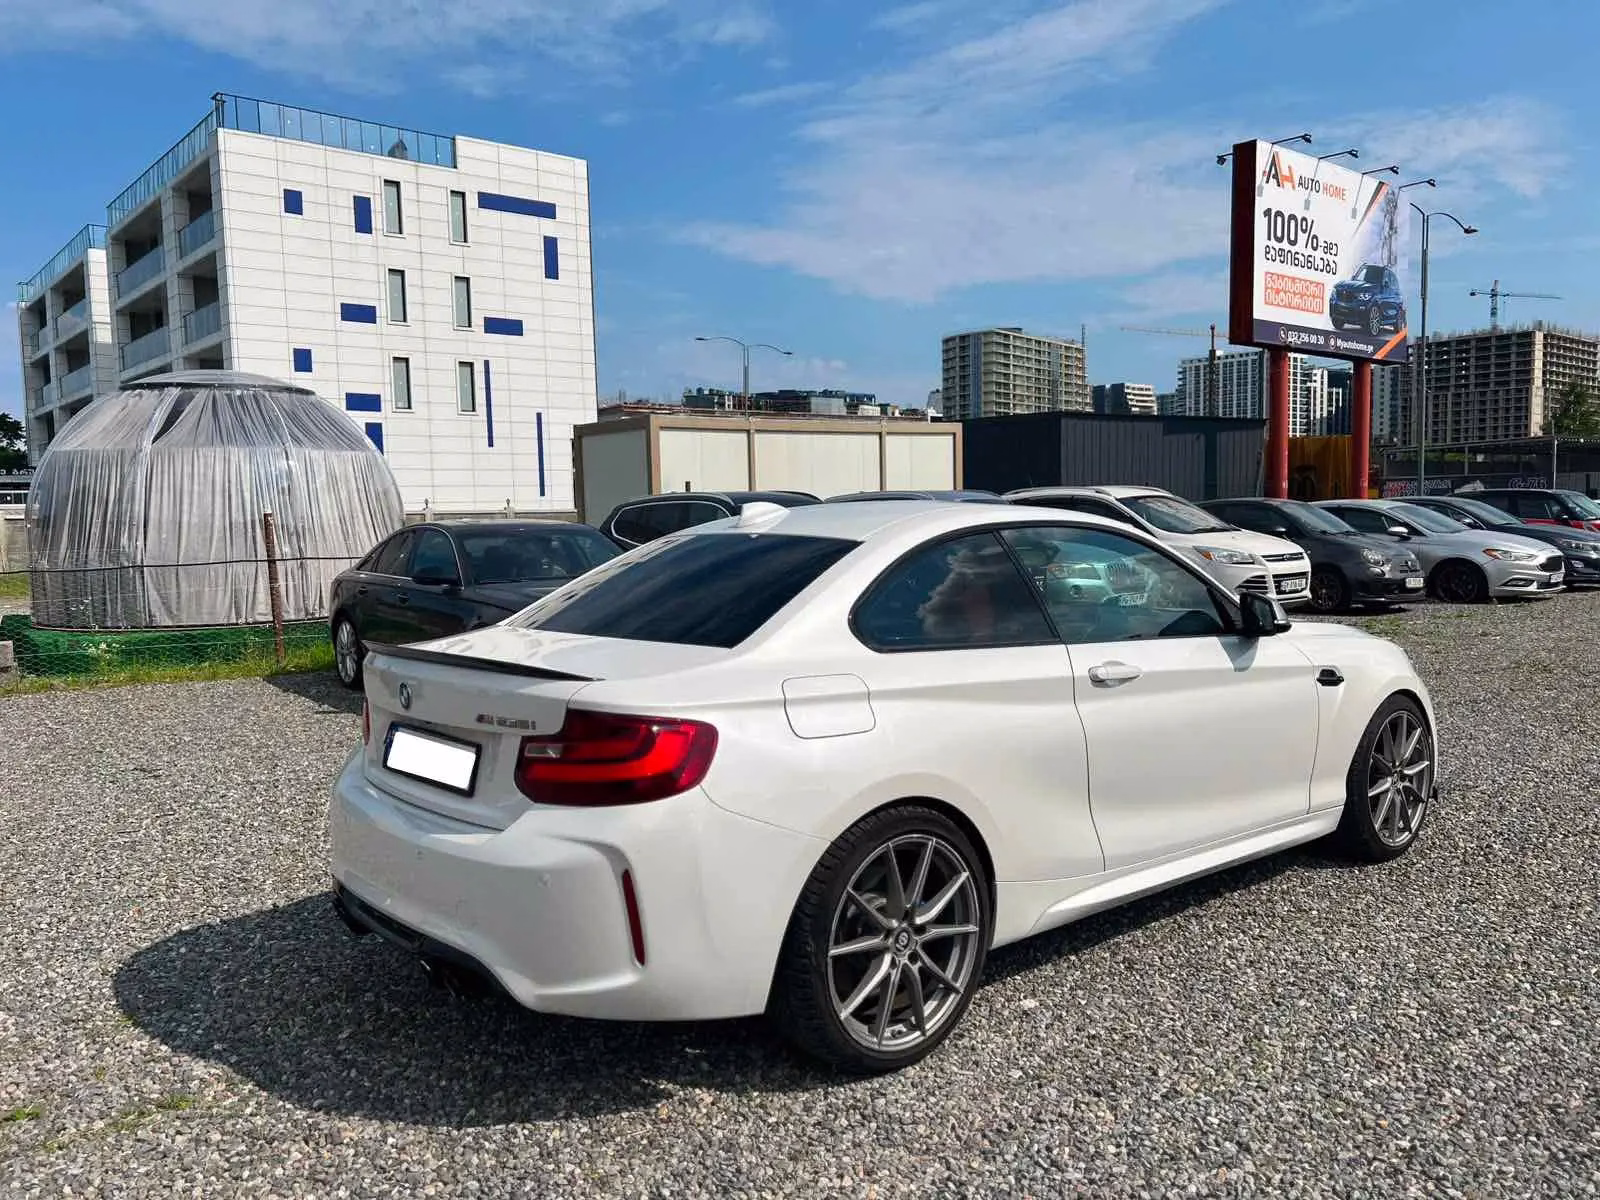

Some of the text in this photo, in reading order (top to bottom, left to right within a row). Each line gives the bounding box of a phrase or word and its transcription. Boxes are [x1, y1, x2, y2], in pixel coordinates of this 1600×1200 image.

[1298, 175, 1321, 193] AUTO
[1323, 183, 1347, 200] HOME
[1264, 244, 1338, 276] დაფინანსება
[1310, 334, 1317, 344] 00
[1317, 335, 1325, 345] 30
